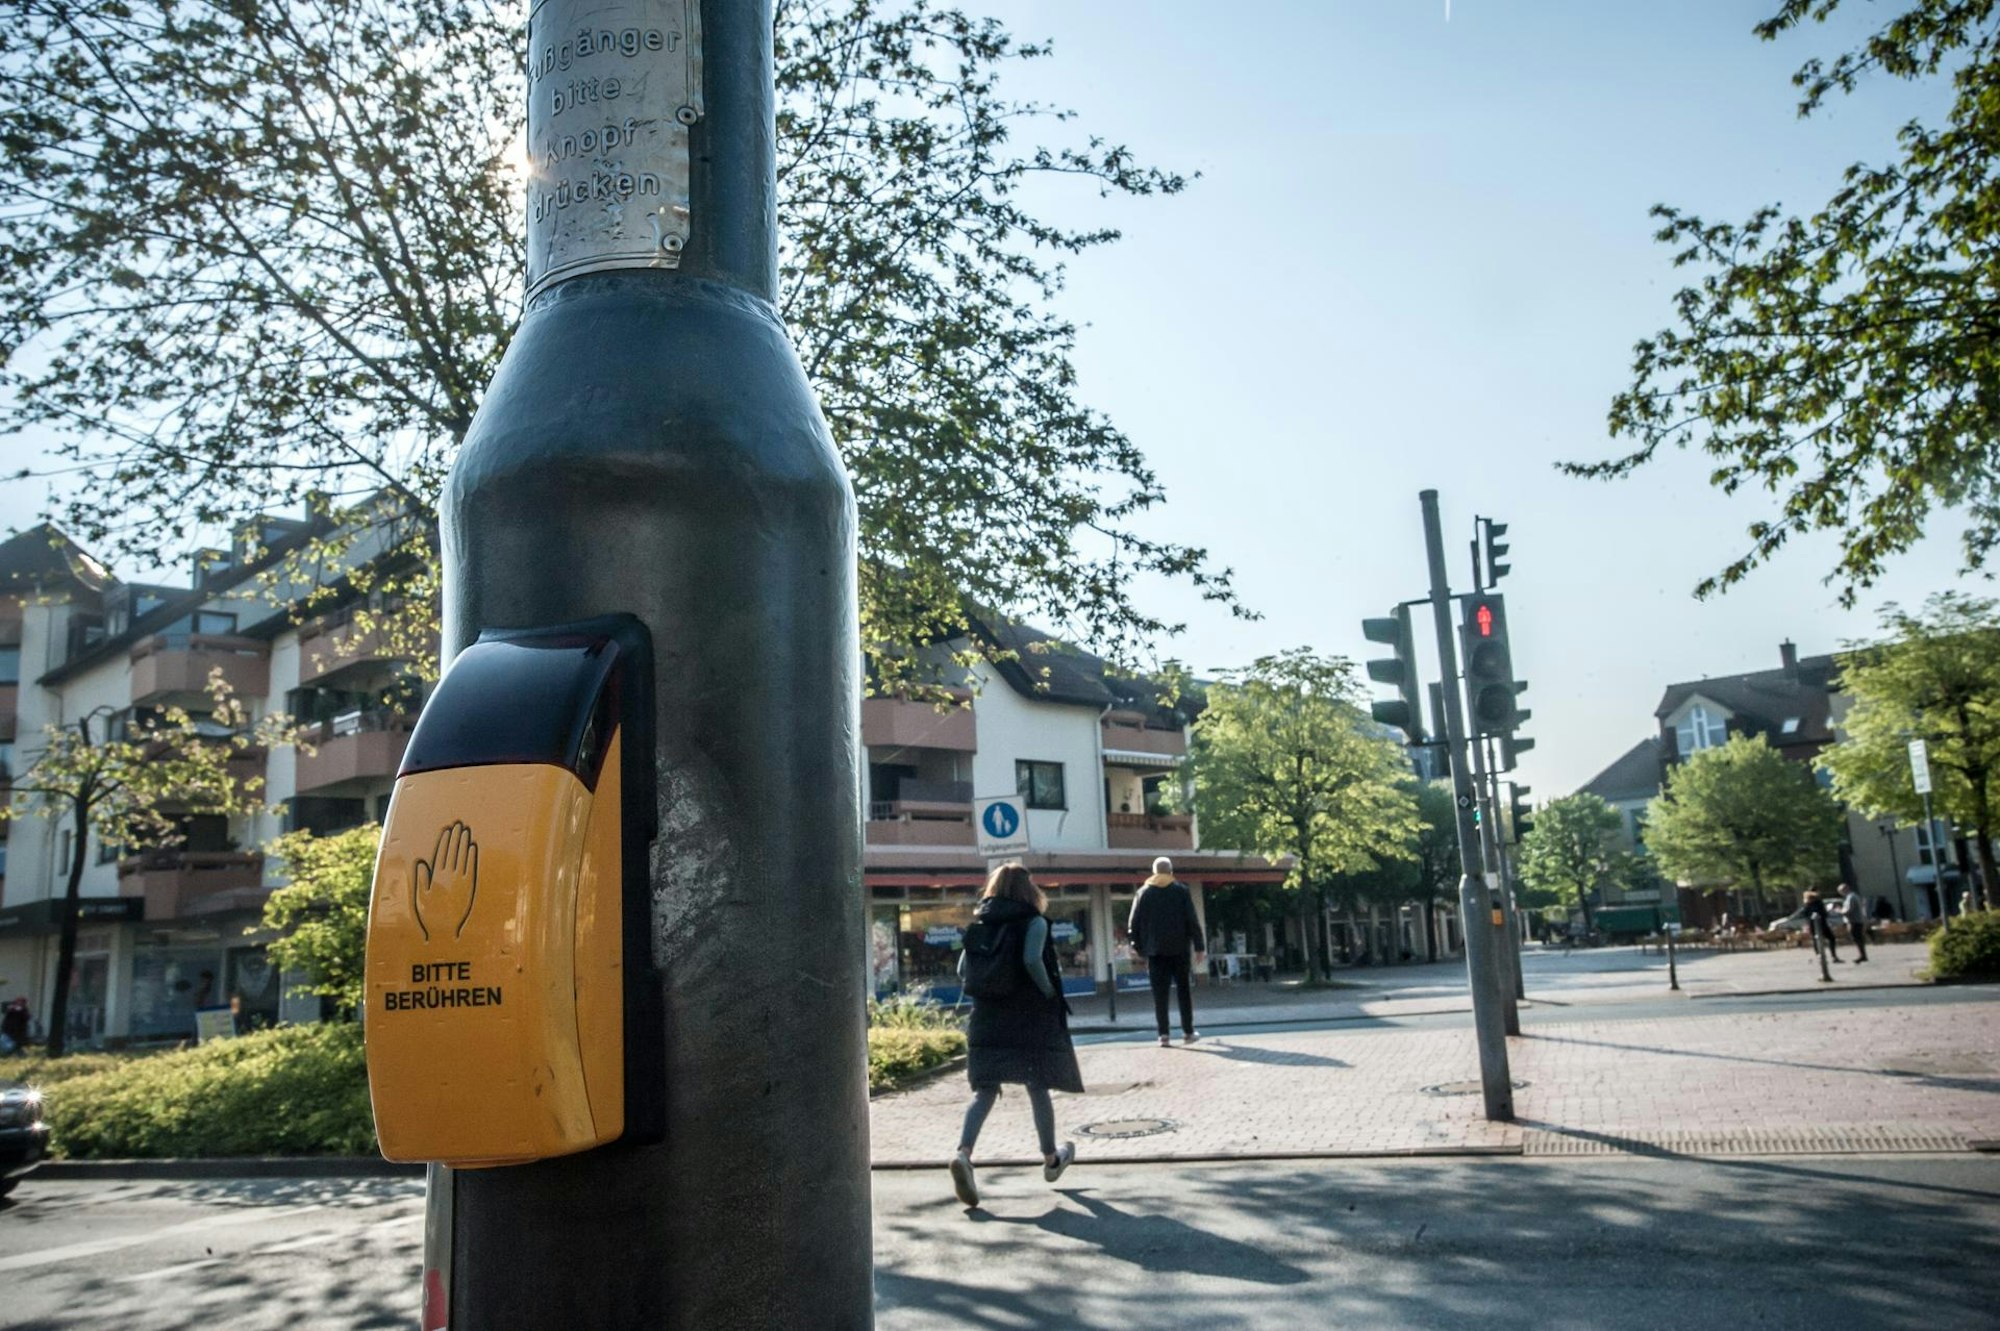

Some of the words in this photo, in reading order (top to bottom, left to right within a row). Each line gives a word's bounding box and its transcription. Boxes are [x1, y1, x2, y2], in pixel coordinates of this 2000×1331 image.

[551, 77, 622, 116] bitte
[535, 170, 660, 224] drücken
[412, 961, 471, 983] BITTE
[385, 986, 502, 1011] BERÜHREN
